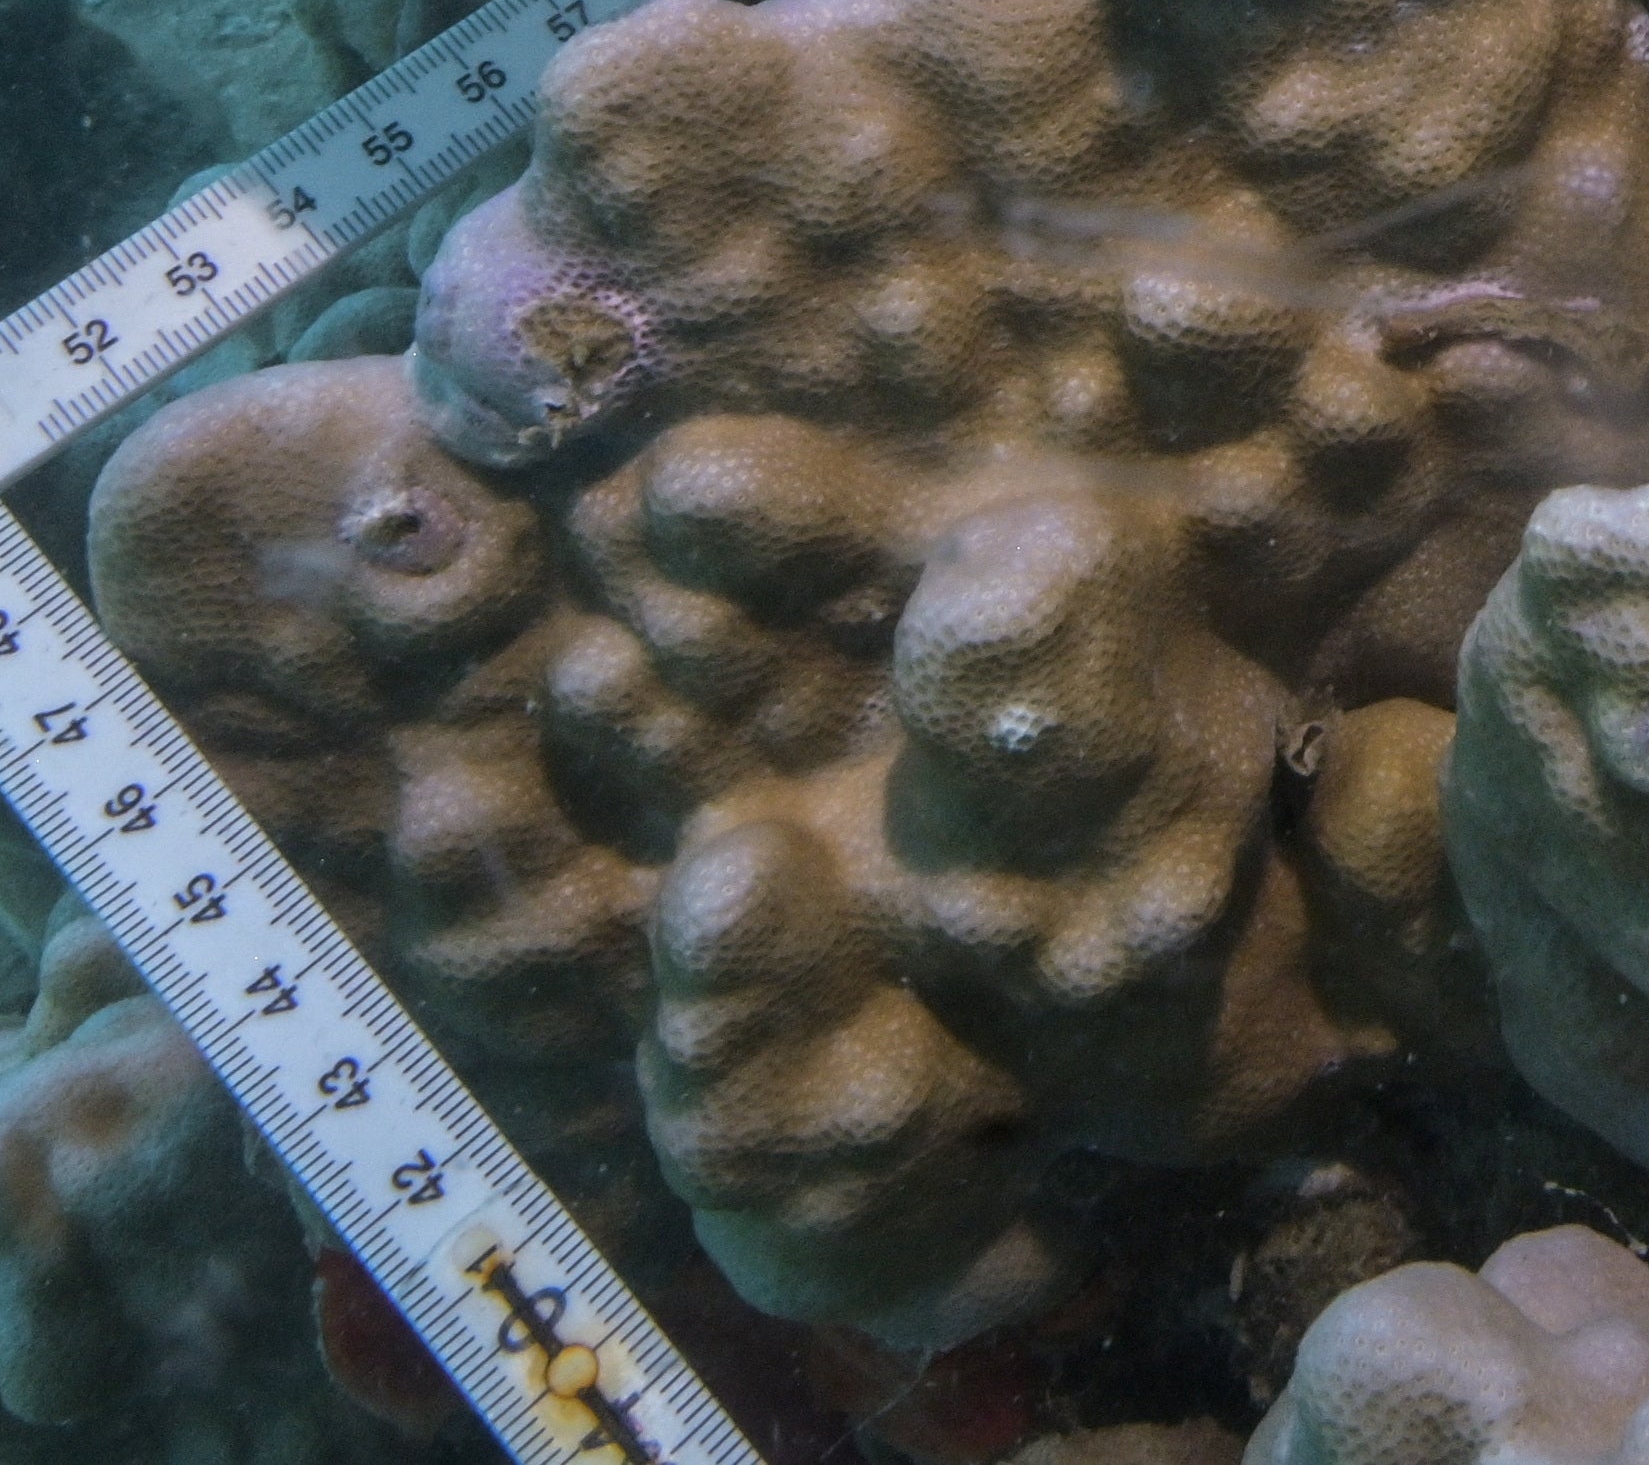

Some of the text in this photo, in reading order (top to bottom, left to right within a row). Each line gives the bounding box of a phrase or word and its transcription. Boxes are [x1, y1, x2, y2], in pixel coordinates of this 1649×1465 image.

[62, 318, 118, 365] 52
[165, 252, 218, 296] 53
[266, 186, 317, 228] 54
[362, 122, 414, 166] 55
[455, 60, 507, 102] 56
[547, 0, 591, 41] 57
[34, 700, 88, 747] 47
[104, 783, 157, 833] 46
[173, 874, 227, 924] 45
[244, 964, 299, 1017] 44
[319, 1056, 373, 1111] 43
[391, 1149, 445, 1206] 42
